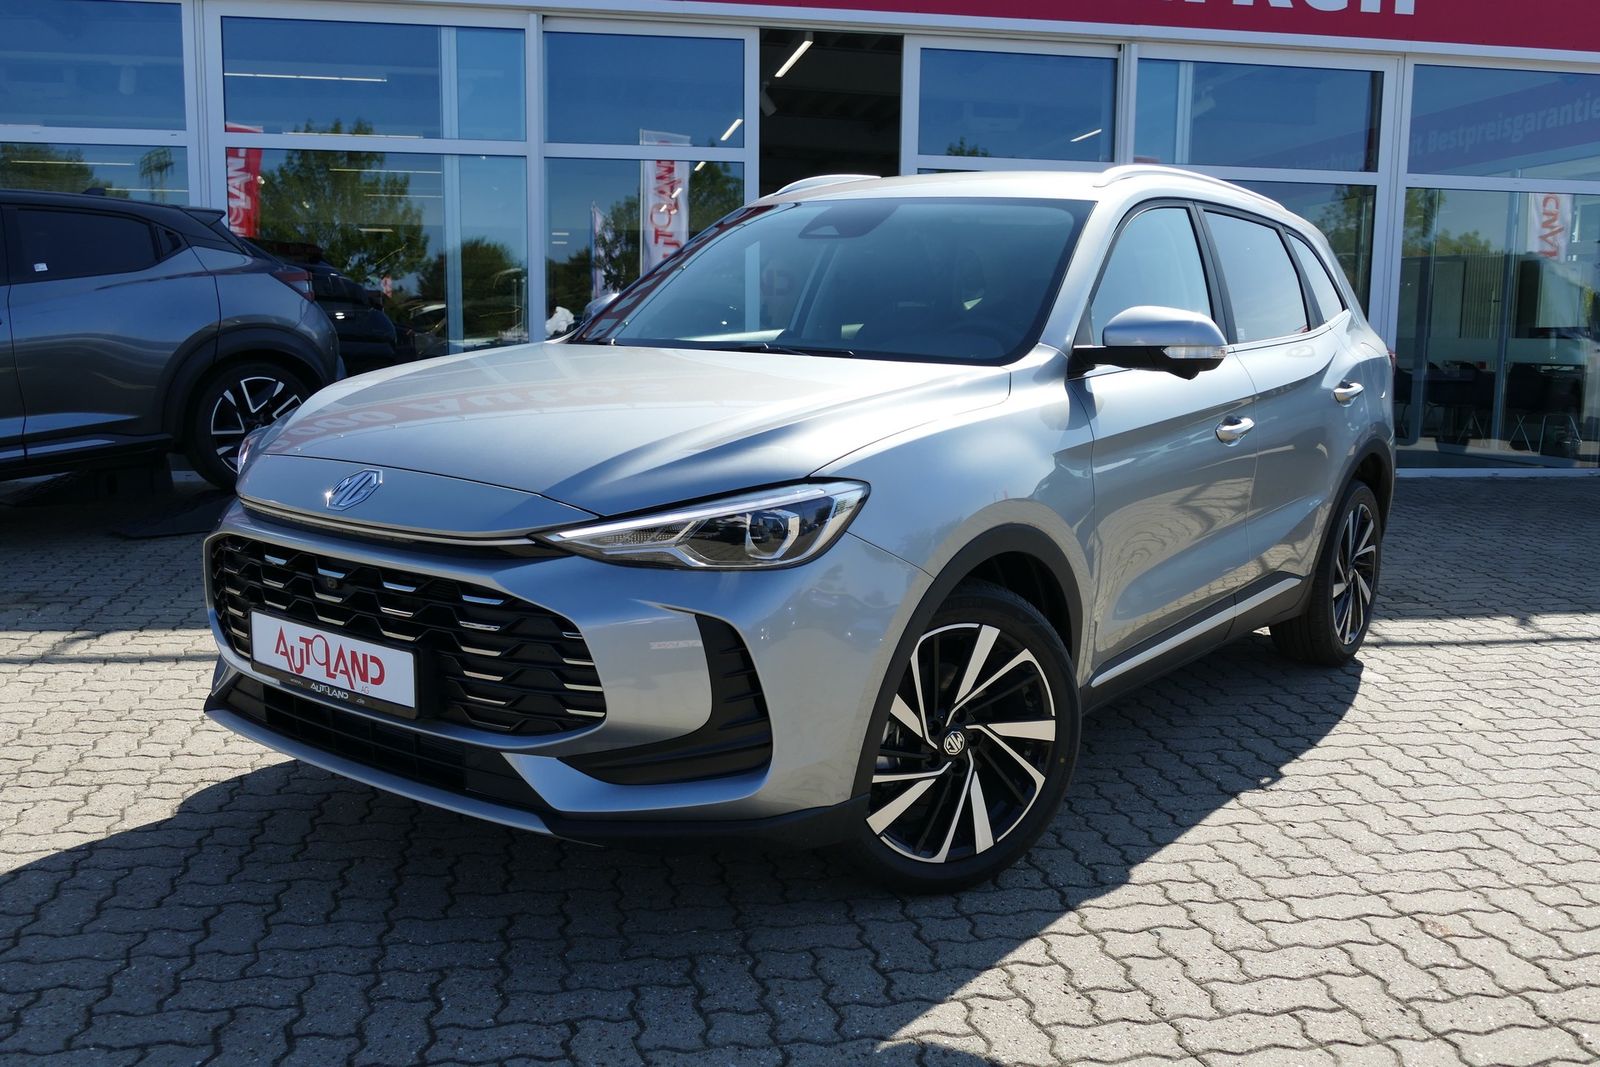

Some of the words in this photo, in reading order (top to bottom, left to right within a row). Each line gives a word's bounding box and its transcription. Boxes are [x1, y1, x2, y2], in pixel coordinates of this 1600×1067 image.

[1428, 92, 1600, 153] Bestpreisgarantie
[275, 625, 385, 690] AUTOLAND
[310, 682, 349, 699] AUTOLAND
[945, 732, 964, 754] MG
